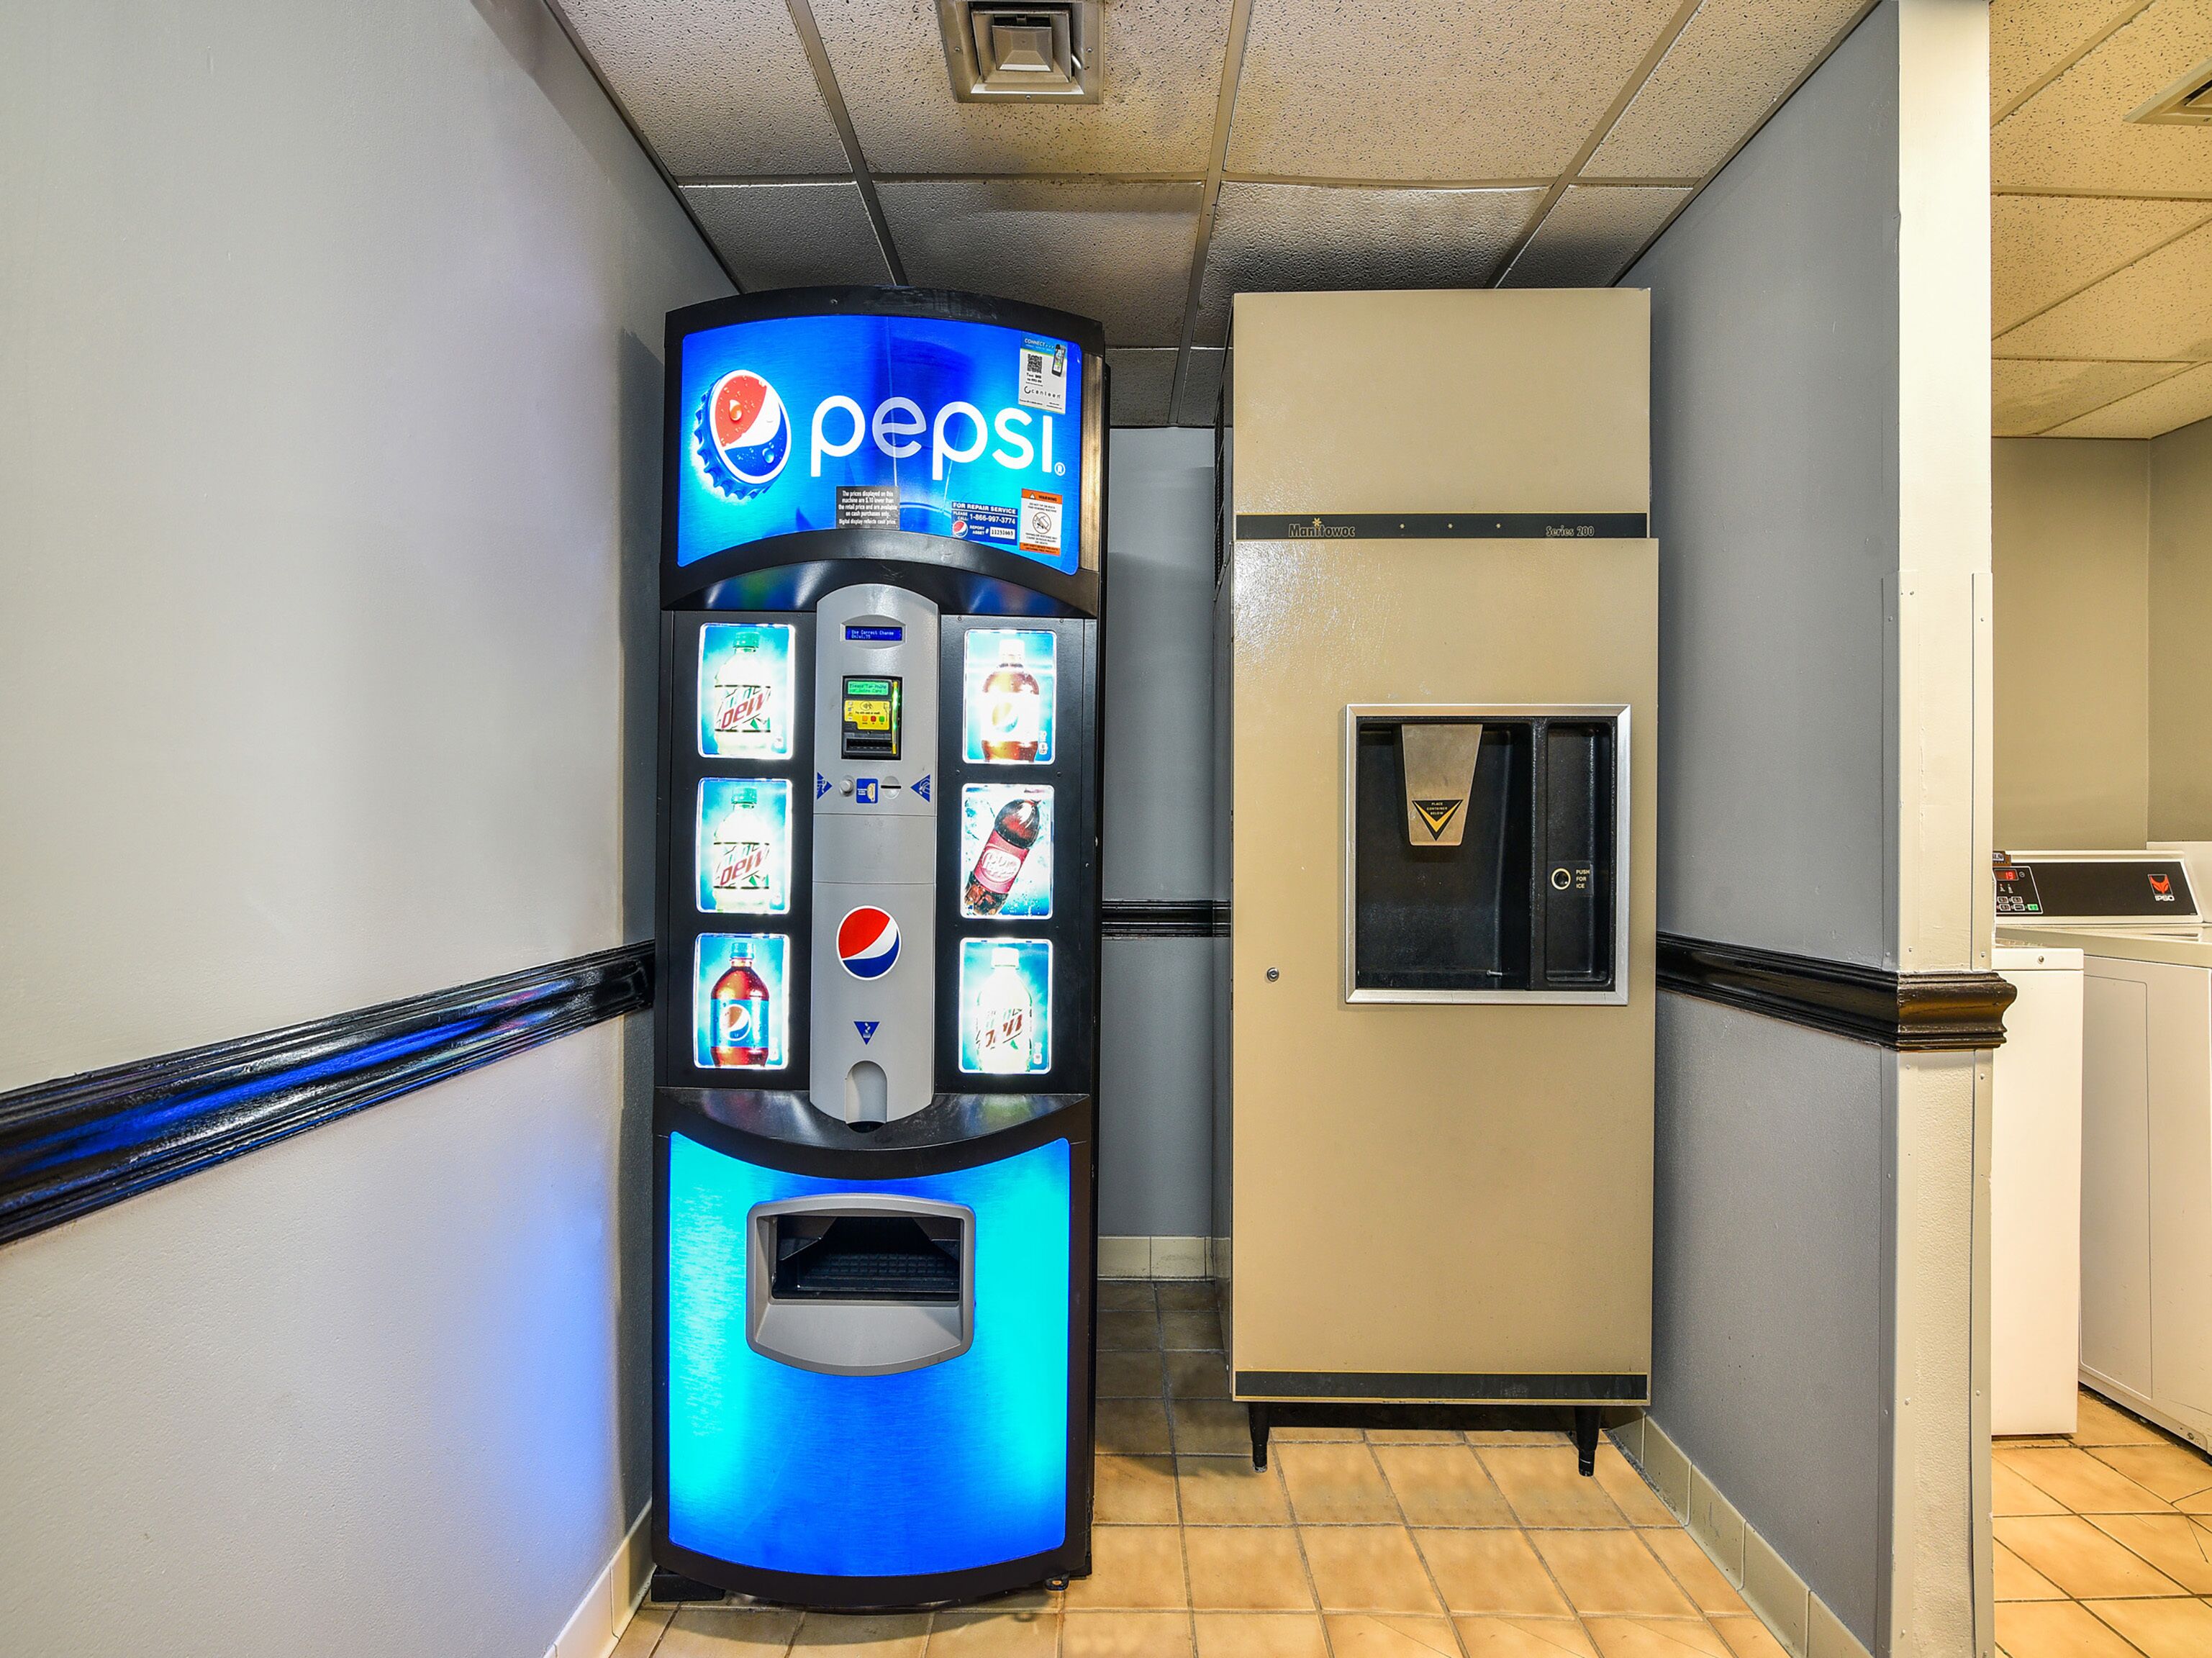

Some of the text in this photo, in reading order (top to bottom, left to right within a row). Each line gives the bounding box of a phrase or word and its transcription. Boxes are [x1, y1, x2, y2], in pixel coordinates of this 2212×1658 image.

[811, 395, 1053, 481] pepsi
[1289, 518, 1355, 538] Manitowoc
[1546, 525, 1595, 537] Series 200
